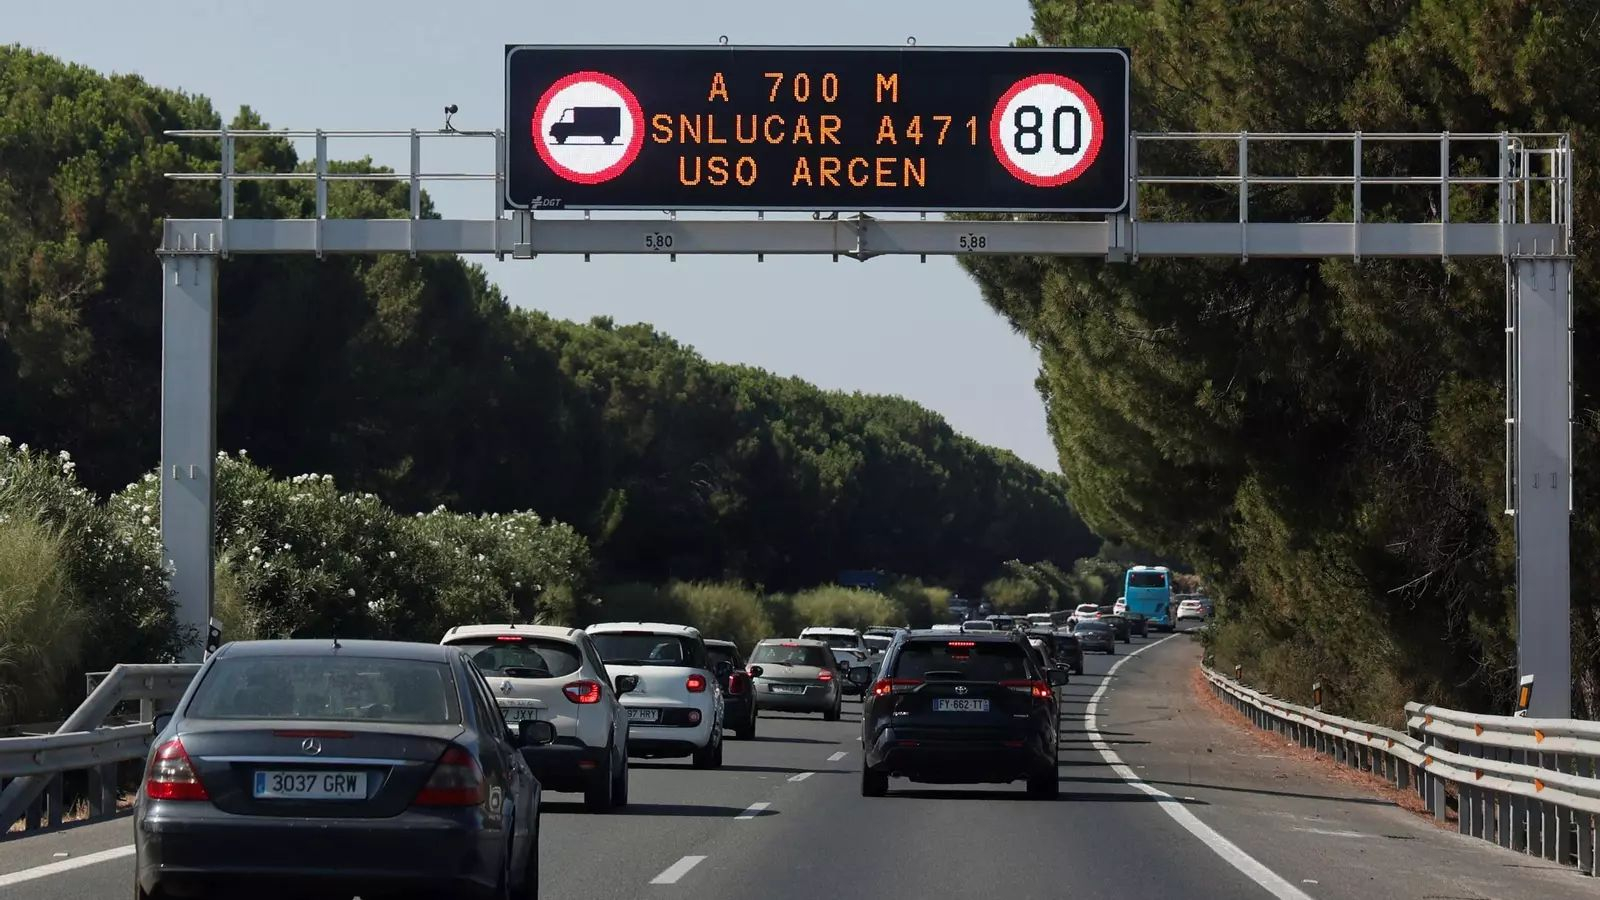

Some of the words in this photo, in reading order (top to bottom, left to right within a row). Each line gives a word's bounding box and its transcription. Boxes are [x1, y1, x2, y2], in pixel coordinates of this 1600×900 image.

[709, 73, 728, 102] A
[764, 73, 838, 103] 700
[876, 73, 898, 103] M
[652, 113, 842, 145] SNLUCAR
[877, 115, 978, 146] A471
[1014, 105, 1082, 155] 80
[679, 156, 757, 186] USO
[793, 156, 926, 187] ARCEN
[543, 198, 562, 207] DGT
[272, 775, 317, 793] 3037
[323, 775, 357, 793] GRW
